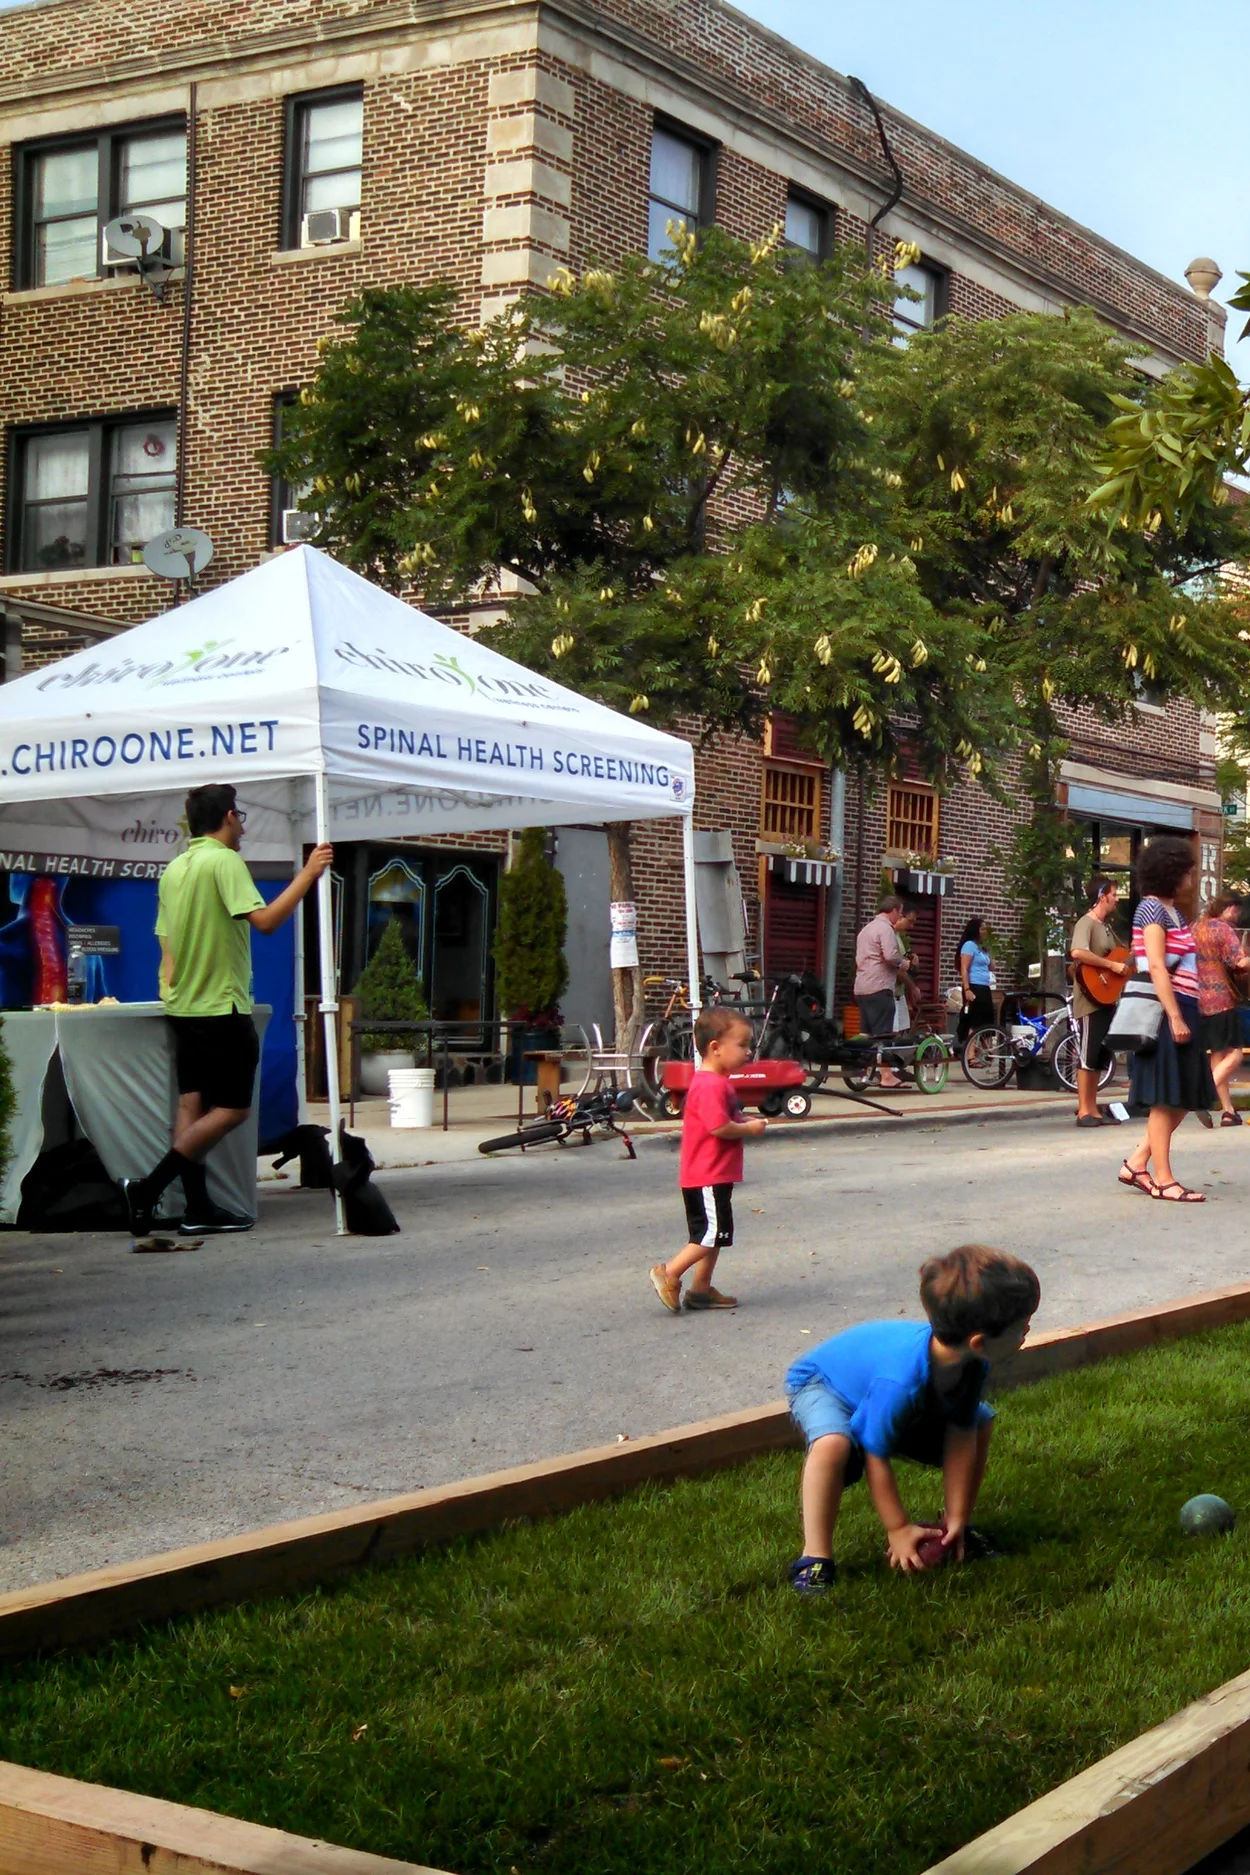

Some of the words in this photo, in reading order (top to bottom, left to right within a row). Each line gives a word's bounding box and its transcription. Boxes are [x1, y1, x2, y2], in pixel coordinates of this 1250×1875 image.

[357, 724, 448, 759] SPINAL
[457, 737, 544, 771] HEALTH
[553, 751, 669, 787] SCREENING
[121, 820, 179, 844] chiro
[45, 856, 115, 877] HEALTH
